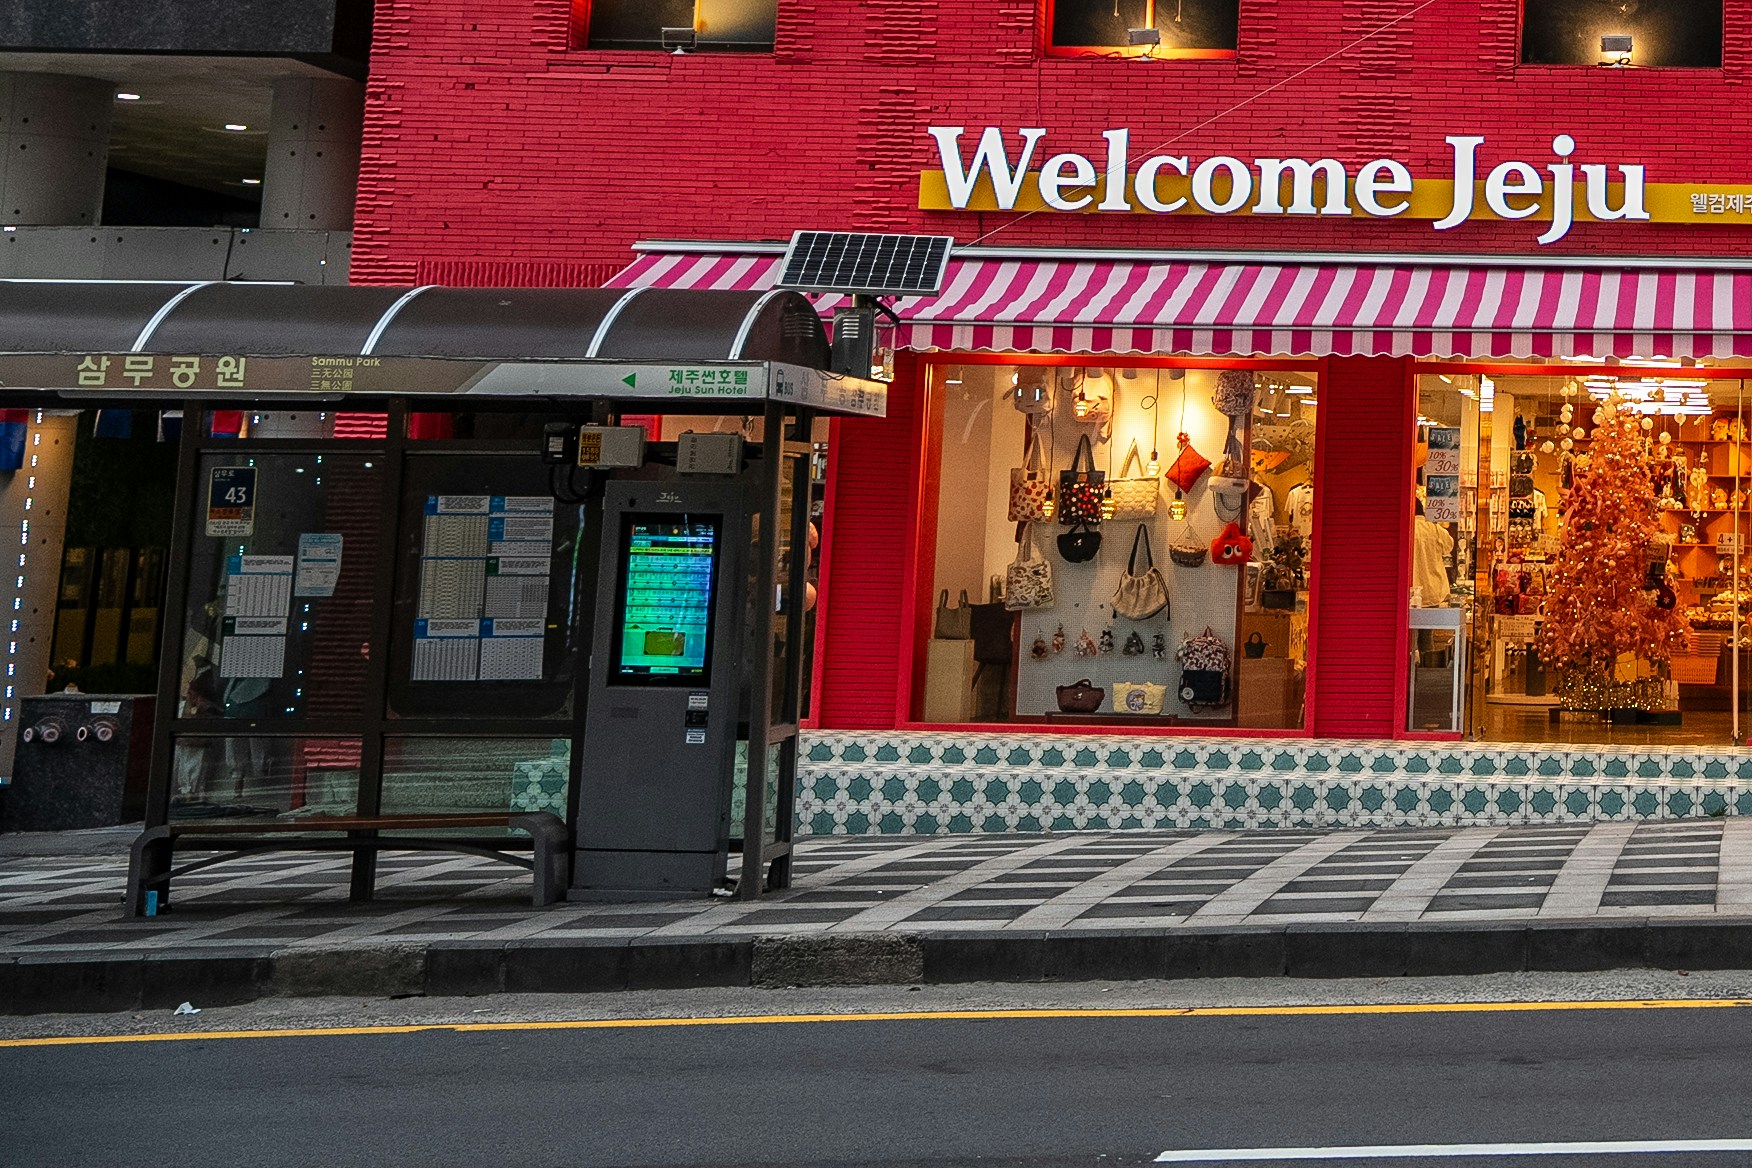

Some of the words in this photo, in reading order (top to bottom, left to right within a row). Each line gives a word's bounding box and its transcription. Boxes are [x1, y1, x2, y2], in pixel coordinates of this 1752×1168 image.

[927, 126, 1415, 218] Welcome
[1432, 134, 1651, 246] Jeju
[311, 356, 353, 366] Sammu
[356, 357, 381, 367] Park
[76, 355, 246, 389] 삼무공원
[668, 369, 748, 385] 제주썬호텔
[668, 385, 692, 396] Jeju
[695, 386, 714, 395] Sun
[718, 385, 747, 395] Hotel
[1430, 433, 1452, 443] SALE
[1429, 451, 1447, 460] 10%
[1435, 460, 1459, 472] 30%
[1428, 480, 1451, 490] SALE
[225, 487, 247, 504] 43
[659, 491, 680, 503] Jeju
[1427, 498, 1446, 508] 10%
[1433, 508, 1458, 520] 30%
